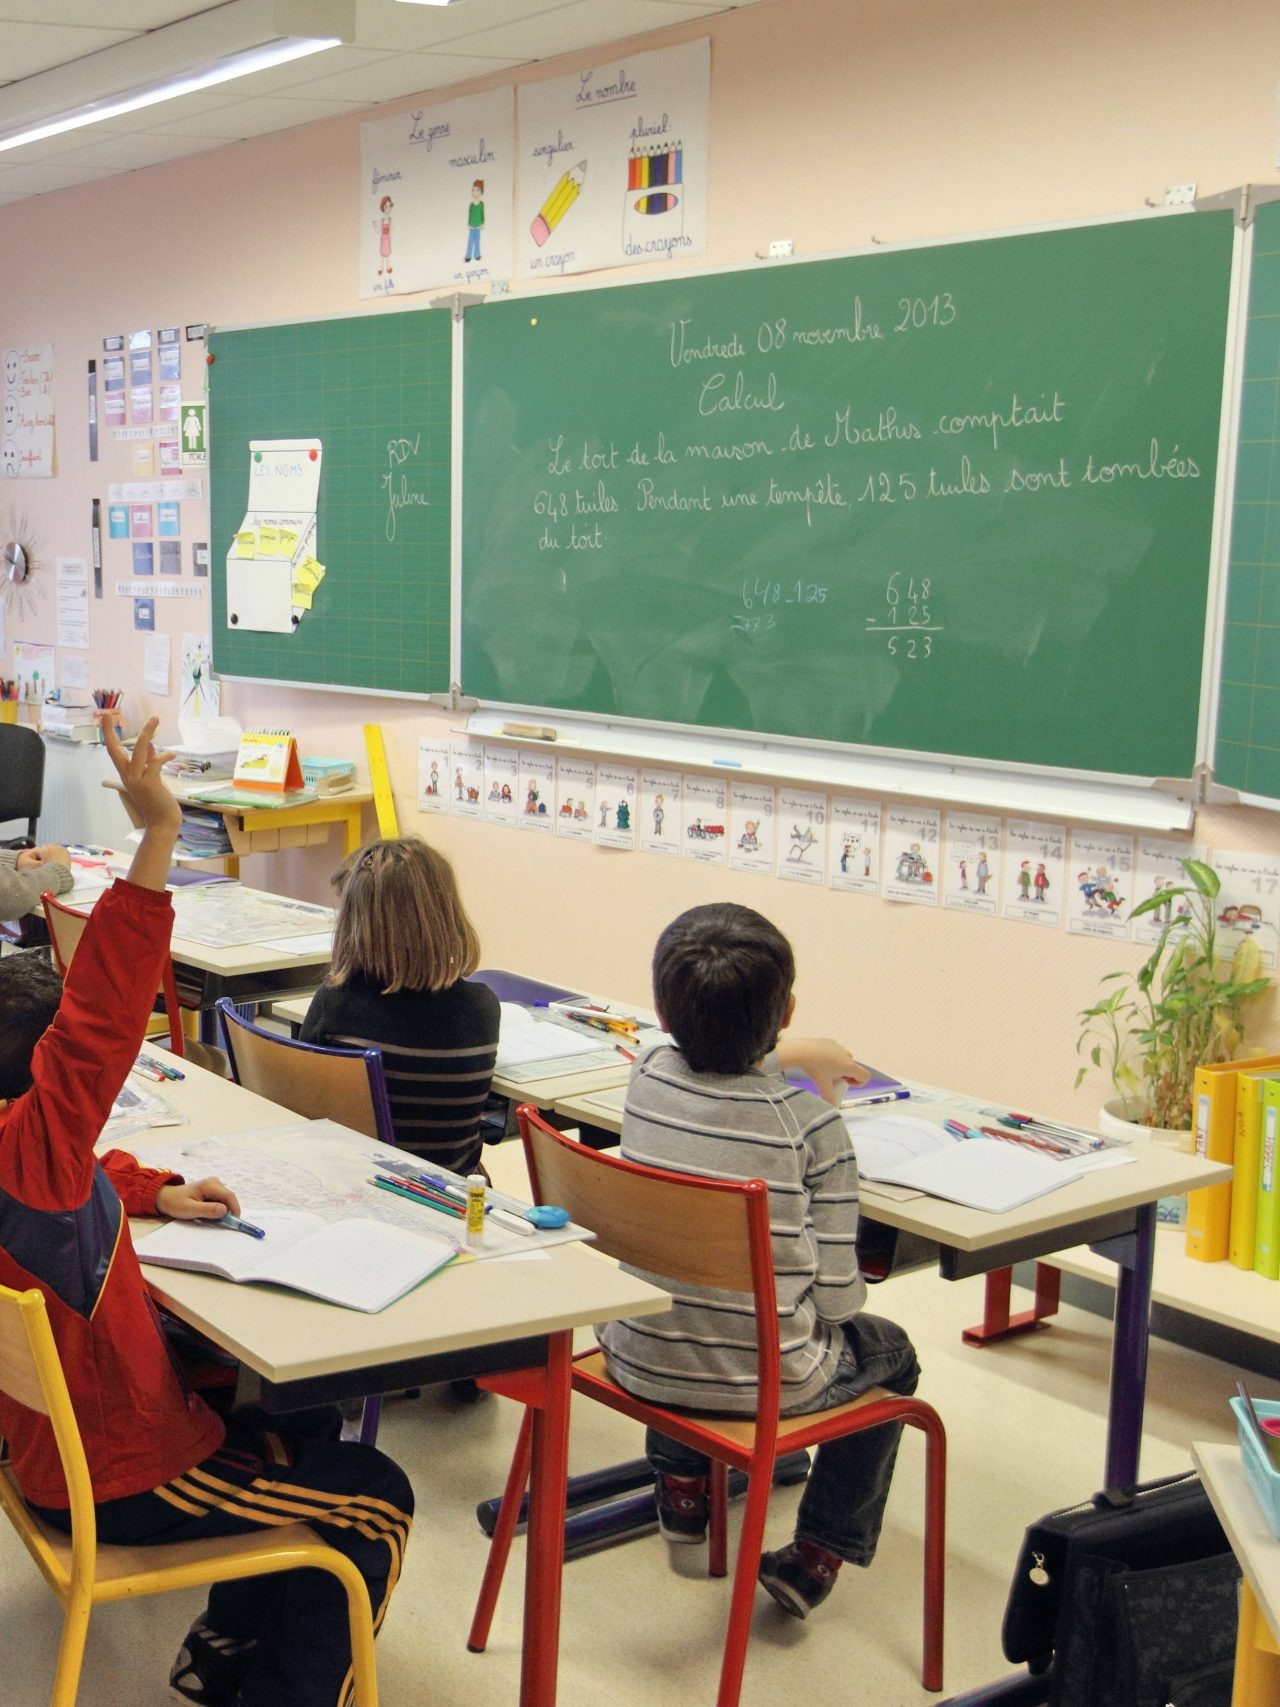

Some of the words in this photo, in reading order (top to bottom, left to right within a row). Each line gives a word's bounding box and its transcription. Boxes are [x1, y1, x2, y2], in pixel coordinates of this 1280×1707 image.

[576, 71, 592, 102] Le
[596, 70, 635, 99] nombre
[409, 111, 424, 140] Le
[427, 123, 450, 152] genre
[449, 138, 495, 167] masculin
[625, 235, 643, 256] des
[643, 236, 692, 258] crayons
[545, 250, 576, 273] crayon
[669, 319, 746, 367] Vendredi
[757, 318, 787, 352] 08
[793, 296, 883, 345] novembre
[894, 293, 956, 332] 2013
[698, 371, 785, 416] Calcul
[548, 435, 571, 475] Le
[579, 441, 618, 470] toit
[627, 442, 650, 465] de
[653, 431, 678, 464] la
[685, 440, 774, 461] maison
[781, 424, 815, 450] de
[825, 405, 921, 446] Mathis
[932, 392, 1065, 450] comptait
[386, 432, 420, 469] RDV
[253, 464, 270, 477] LES
[274, 463, 303, 478] NOMS
[533, 491, 568, 523] 648
[637, 478, 713, 512] Pendant
[720, 493, 759, 508] une
[857, 472, 917, 503] 125
[926, 455, 990, 498] tuiles
[1004, 458, 1072, 493] sont
[1081, 437, 1200, 483] tombées
[539, 527, 560, 549] du
[887, 635, 933, 659] 523
[806, 811, 824, 825] 10
[861, 820, 878, 834] 11
[918, 828, 937, 843] 12
[977, 835, 999, 850] 13
[1040, 844, 1063, 860] 14
[1106, 854, 1131, 872] 15
[1251, 876, 1279, 895] 17
